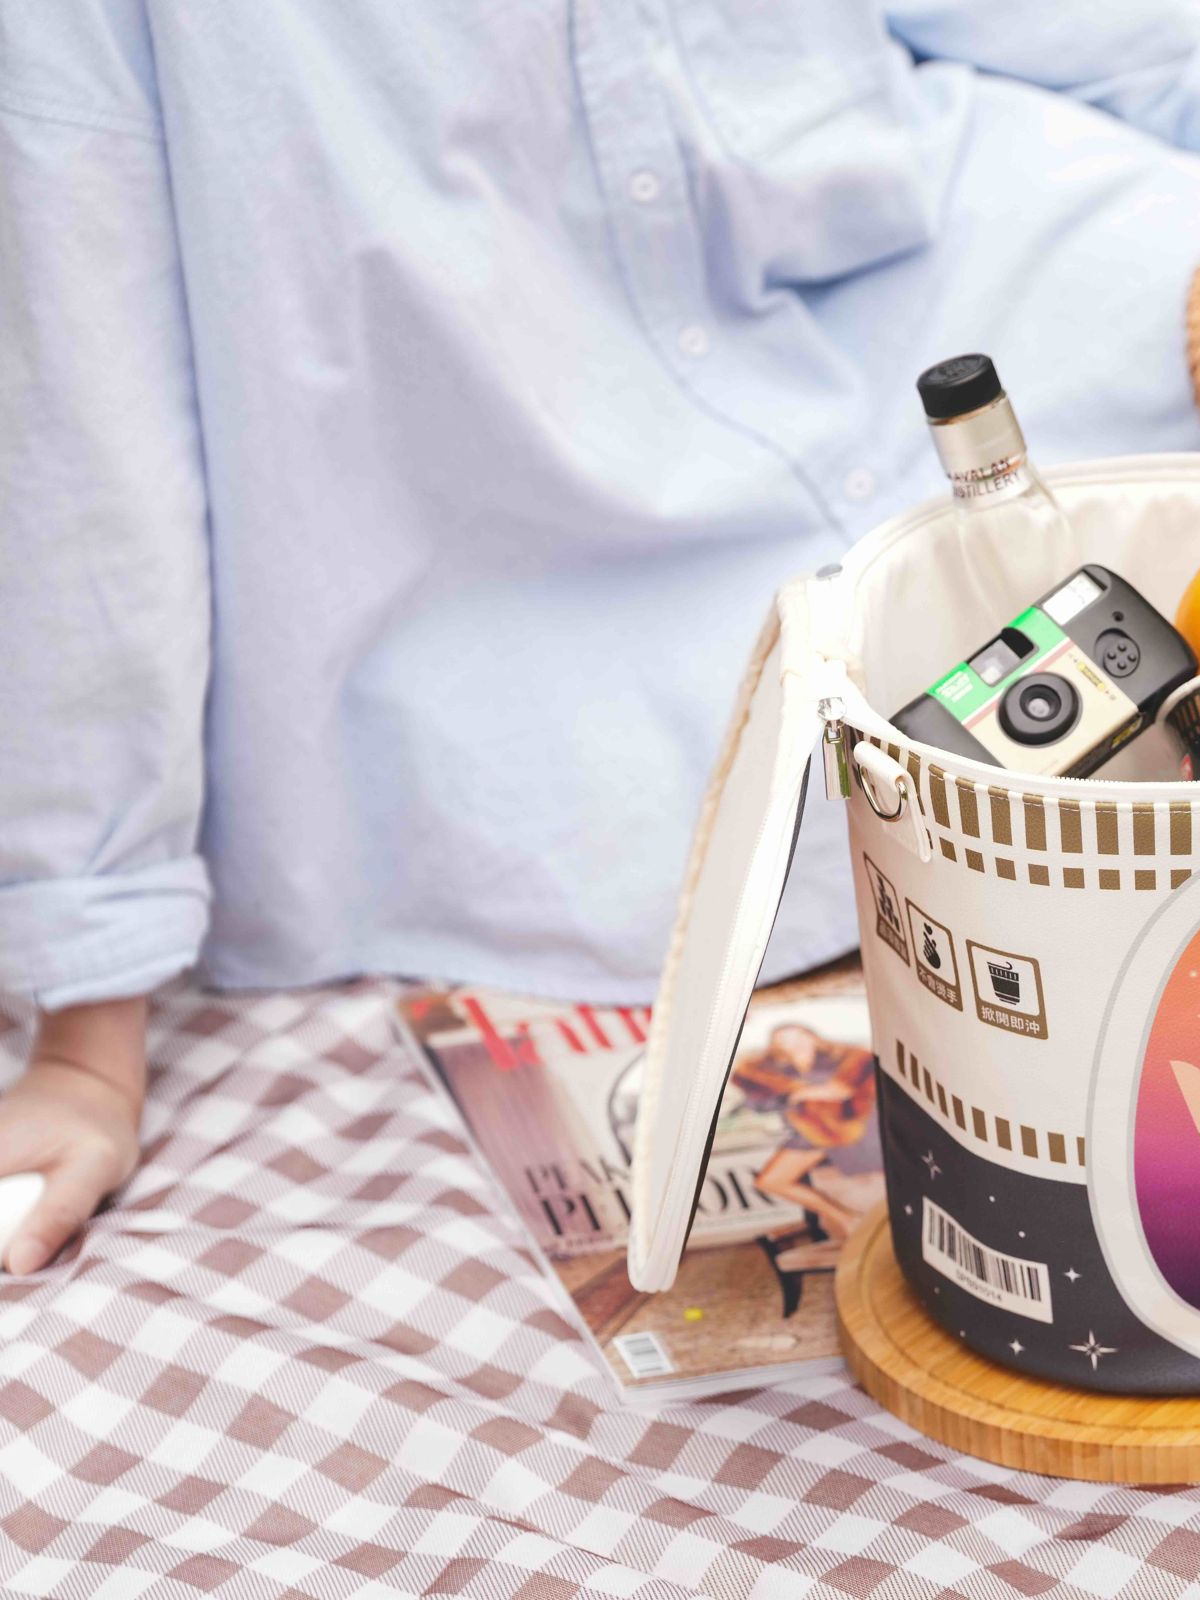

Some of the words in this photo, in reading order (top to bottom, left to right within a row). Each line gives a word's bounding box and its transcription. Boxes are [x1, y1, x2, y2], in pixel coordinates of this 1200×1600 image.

[953, 471, 1021, 499] ISTILLERY
[981, 1005, 1041, 1035] 掀開即沖
